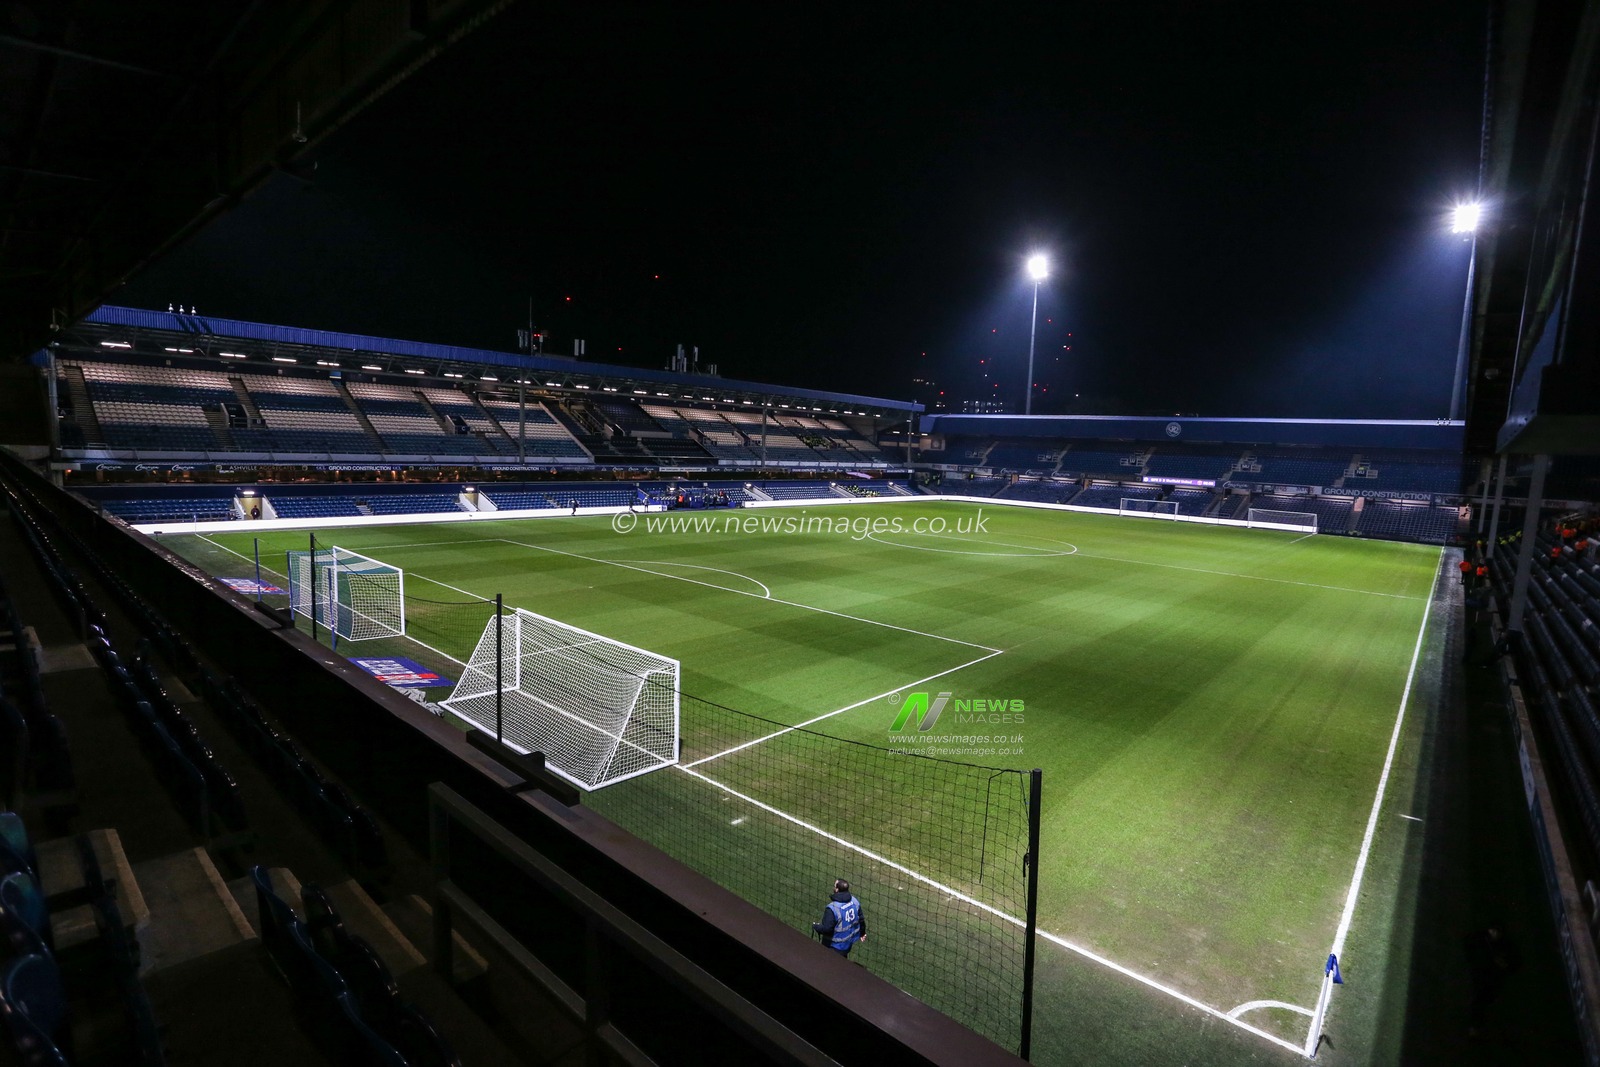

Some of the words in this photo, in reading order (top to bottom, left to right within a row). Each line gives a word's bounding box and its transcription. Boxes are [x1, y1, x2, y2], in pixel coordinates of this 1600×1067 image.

[1324, 487, 1360, 496] GROUND
[1361, 490, 1431, 500] CONSTRUCTION
[845, 908, 855, 922] 43
